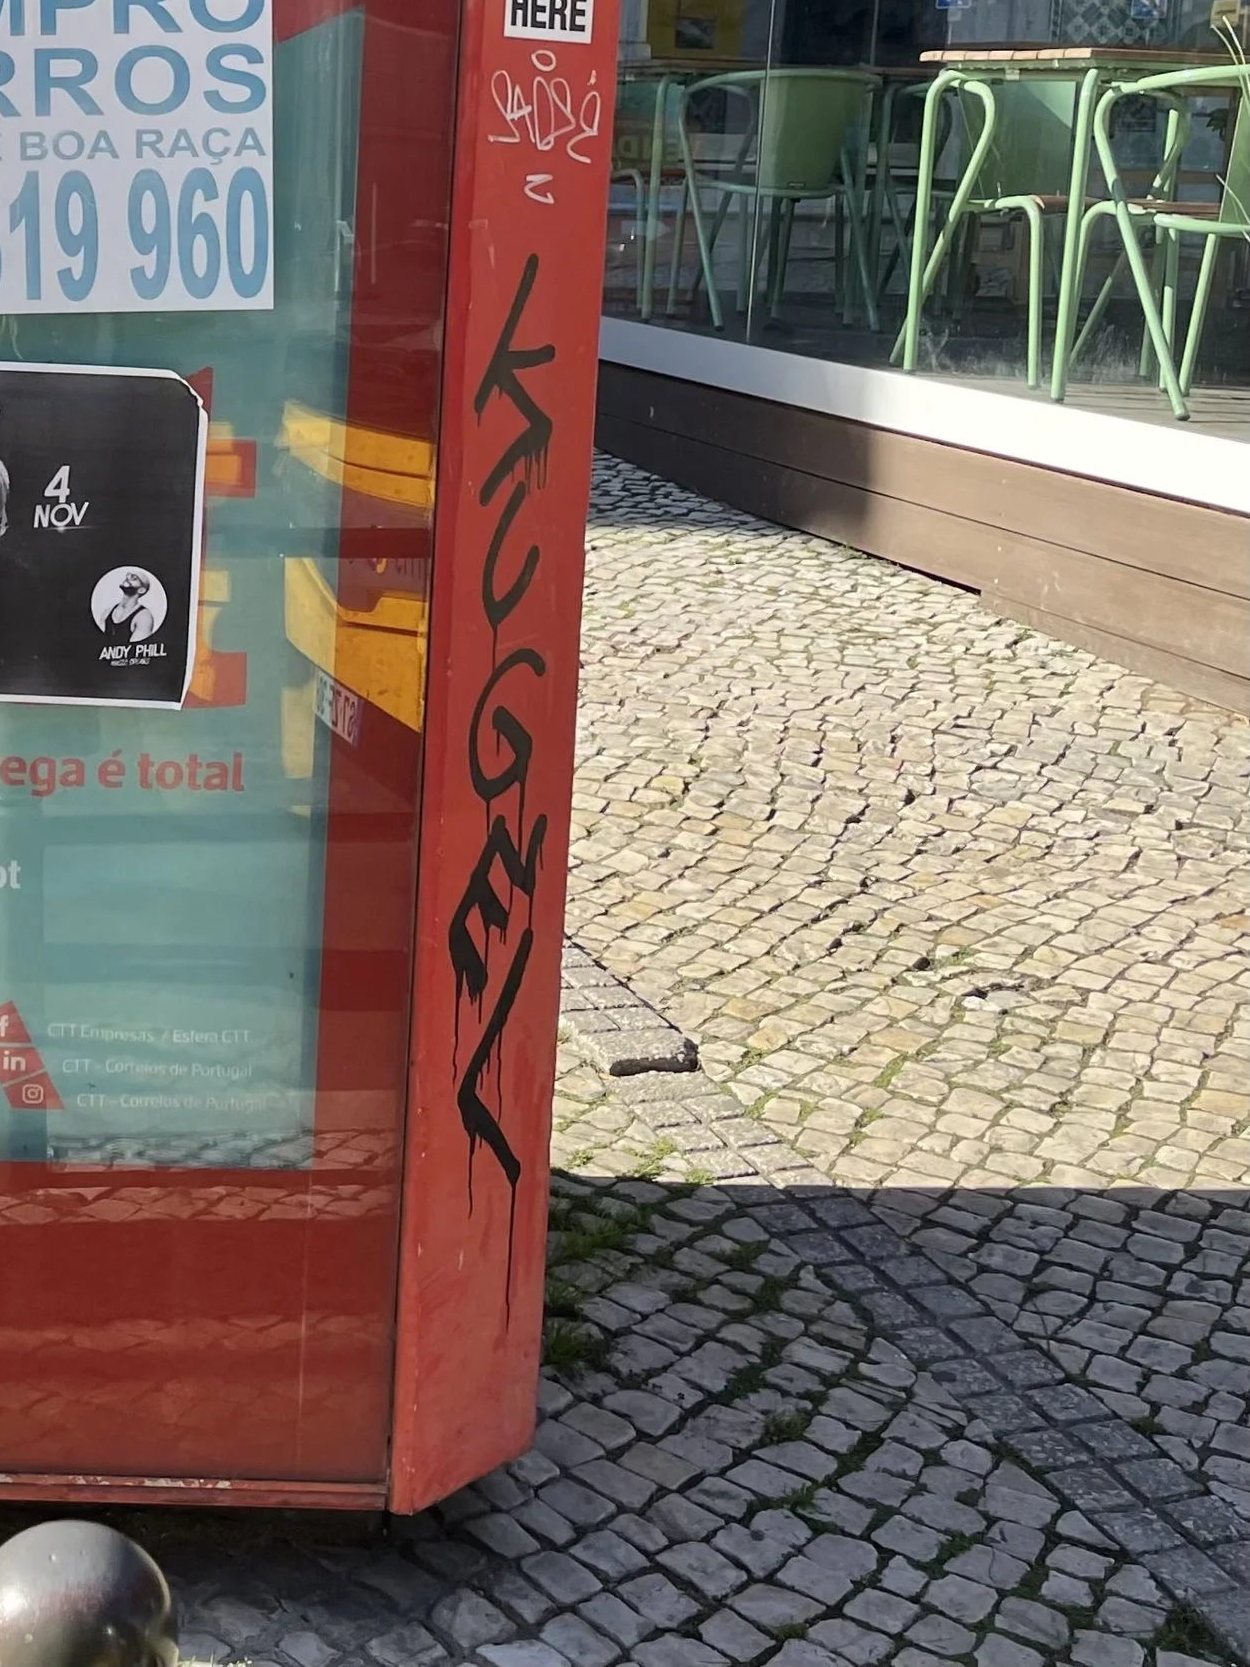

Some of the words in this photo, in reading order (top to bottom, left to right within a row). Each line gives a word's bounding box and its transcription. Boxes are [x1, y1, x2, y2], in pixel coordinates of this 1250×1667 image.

[19, 129, 120, 161] BOA
[134, 126, 267, 166] RAÇA
[127, 166, 270, 301] 960
[43, 465, 71, 503] 4
[33, 501, 90, 529] NOV
[98, 644, 132, 660] ANDY
[135, 642, 167, 658] PHILL
[97, 749, 127, 789] é
[137, 751, 245, 793] total
[47, 1023, 77, 1038] CTT
[80, 1023, 155, 1044] Empresas
[221, 1029, 251, 1044] CTT
[62, 1058, 91, 1074] CTT
[105, 1058, 166, 1076] Correios
[169, 1062, 188, 1077] de
[191, 1062, 252, 1081] Portugal
[76, 1093, 106, 1108] CTT
